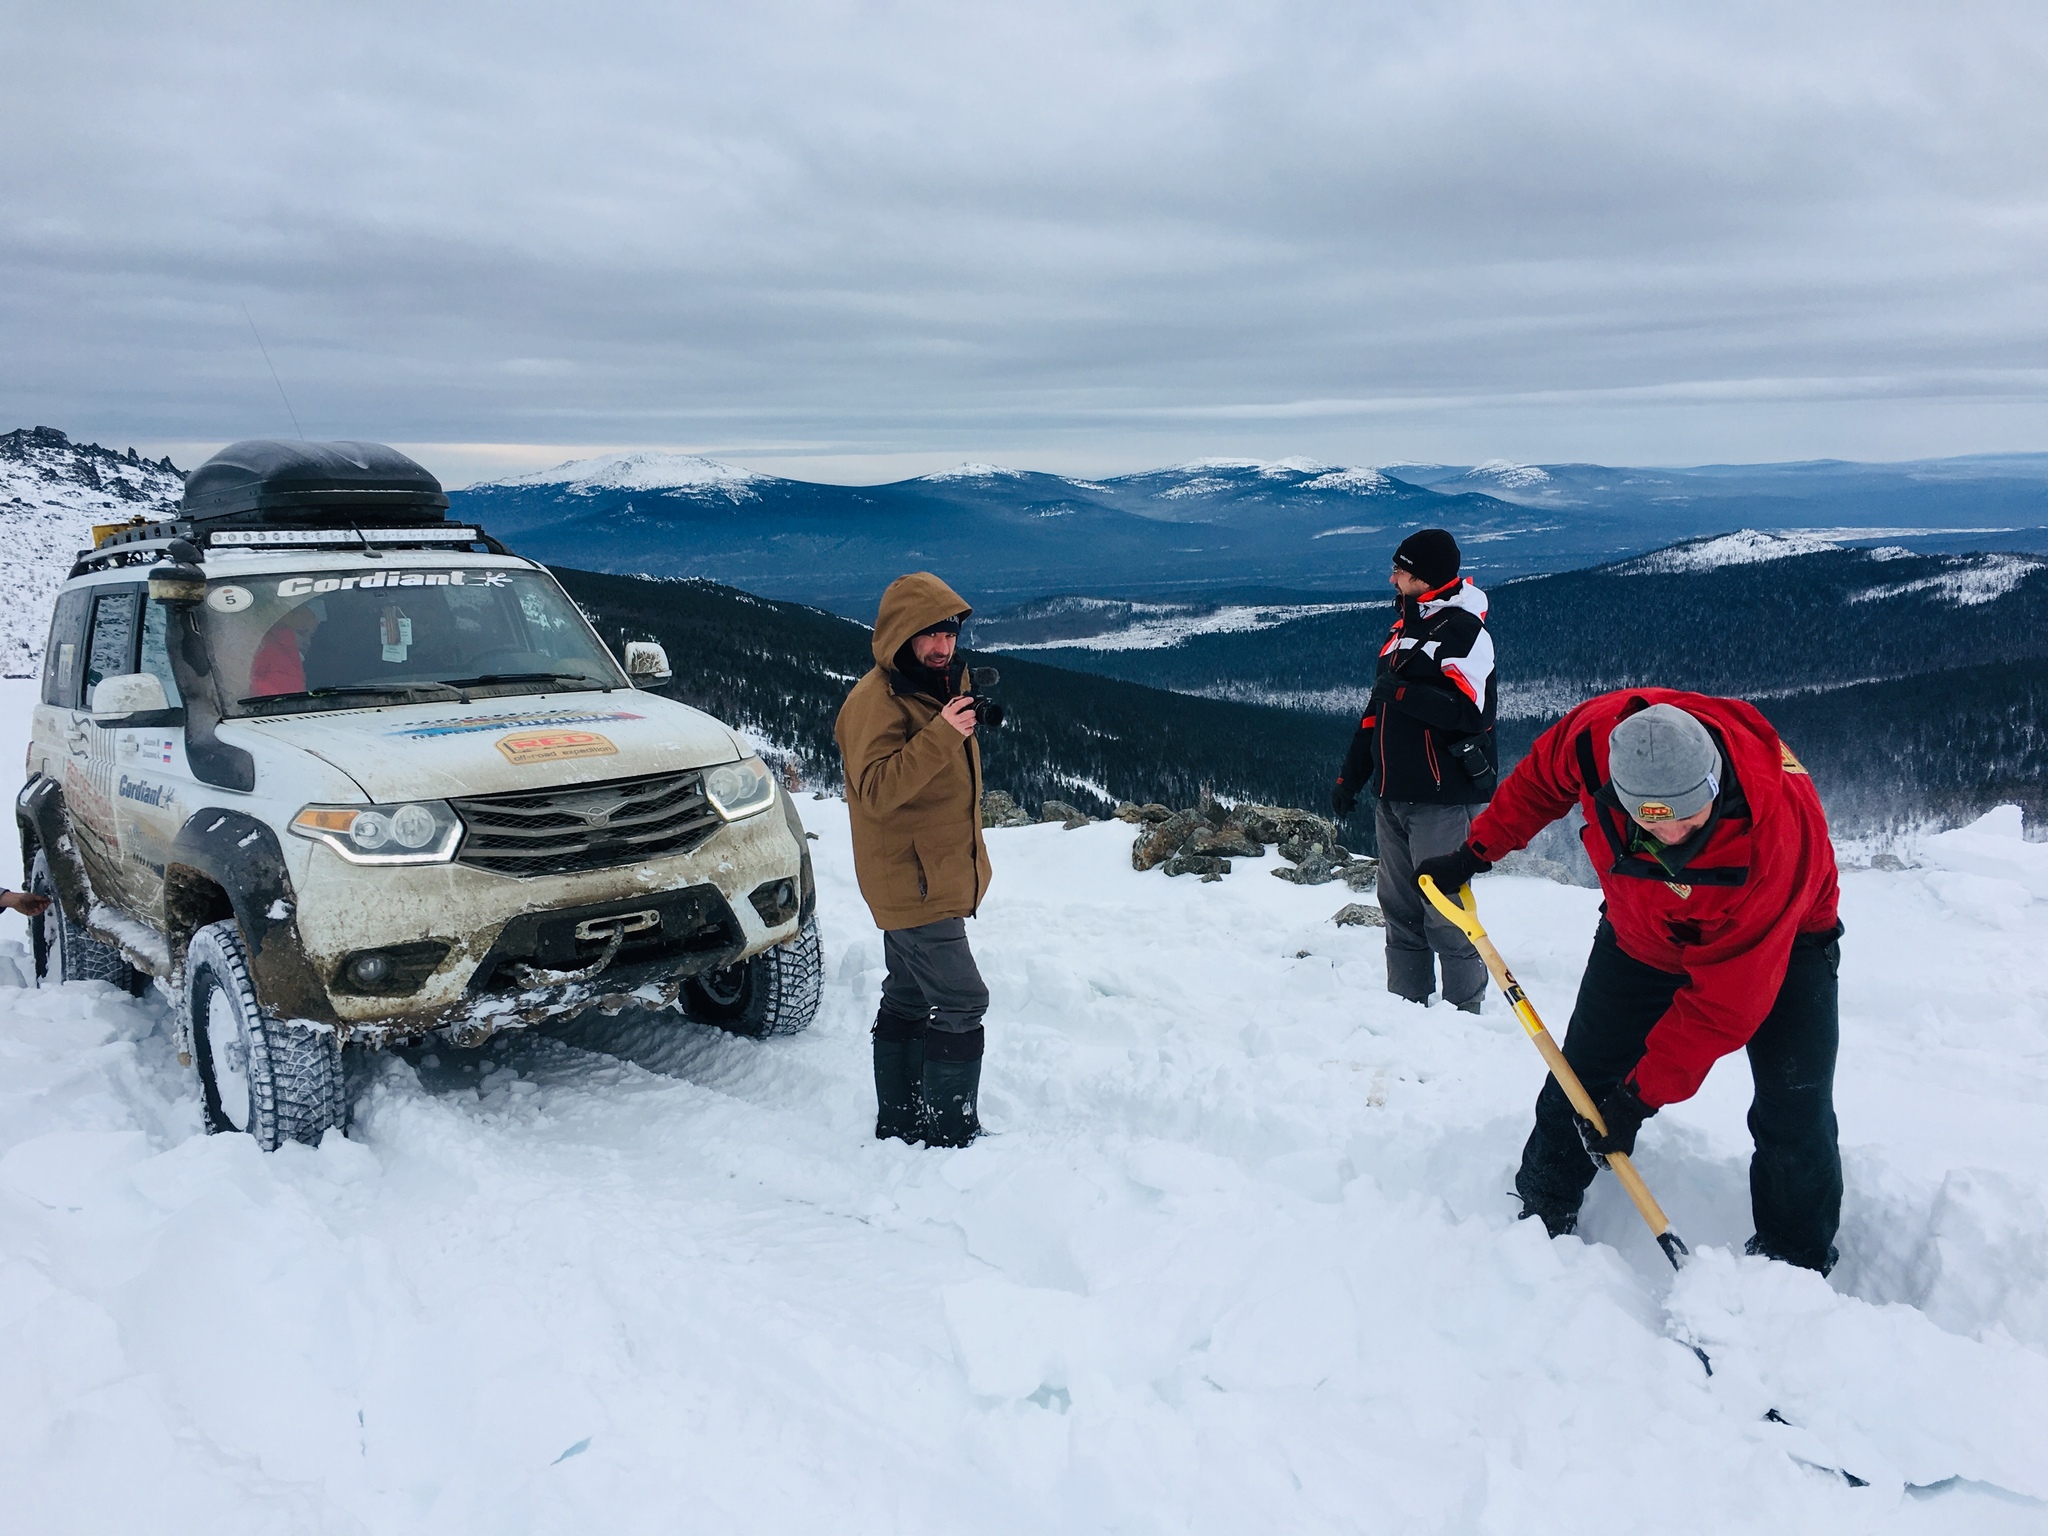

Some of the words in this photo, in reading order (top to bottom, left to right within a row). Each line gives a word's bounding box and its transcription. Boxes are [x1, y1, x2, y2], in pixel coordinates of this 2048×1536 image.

[277, 570, 467, 598] Cordiant
[225, 595, 236, 606] 5
[512, 735, 594, 749] RED
[513, 751, 557, 761] off-road
[562, 745, 613, 757] expedition
[118, 774, 163, 808] Cordiant
